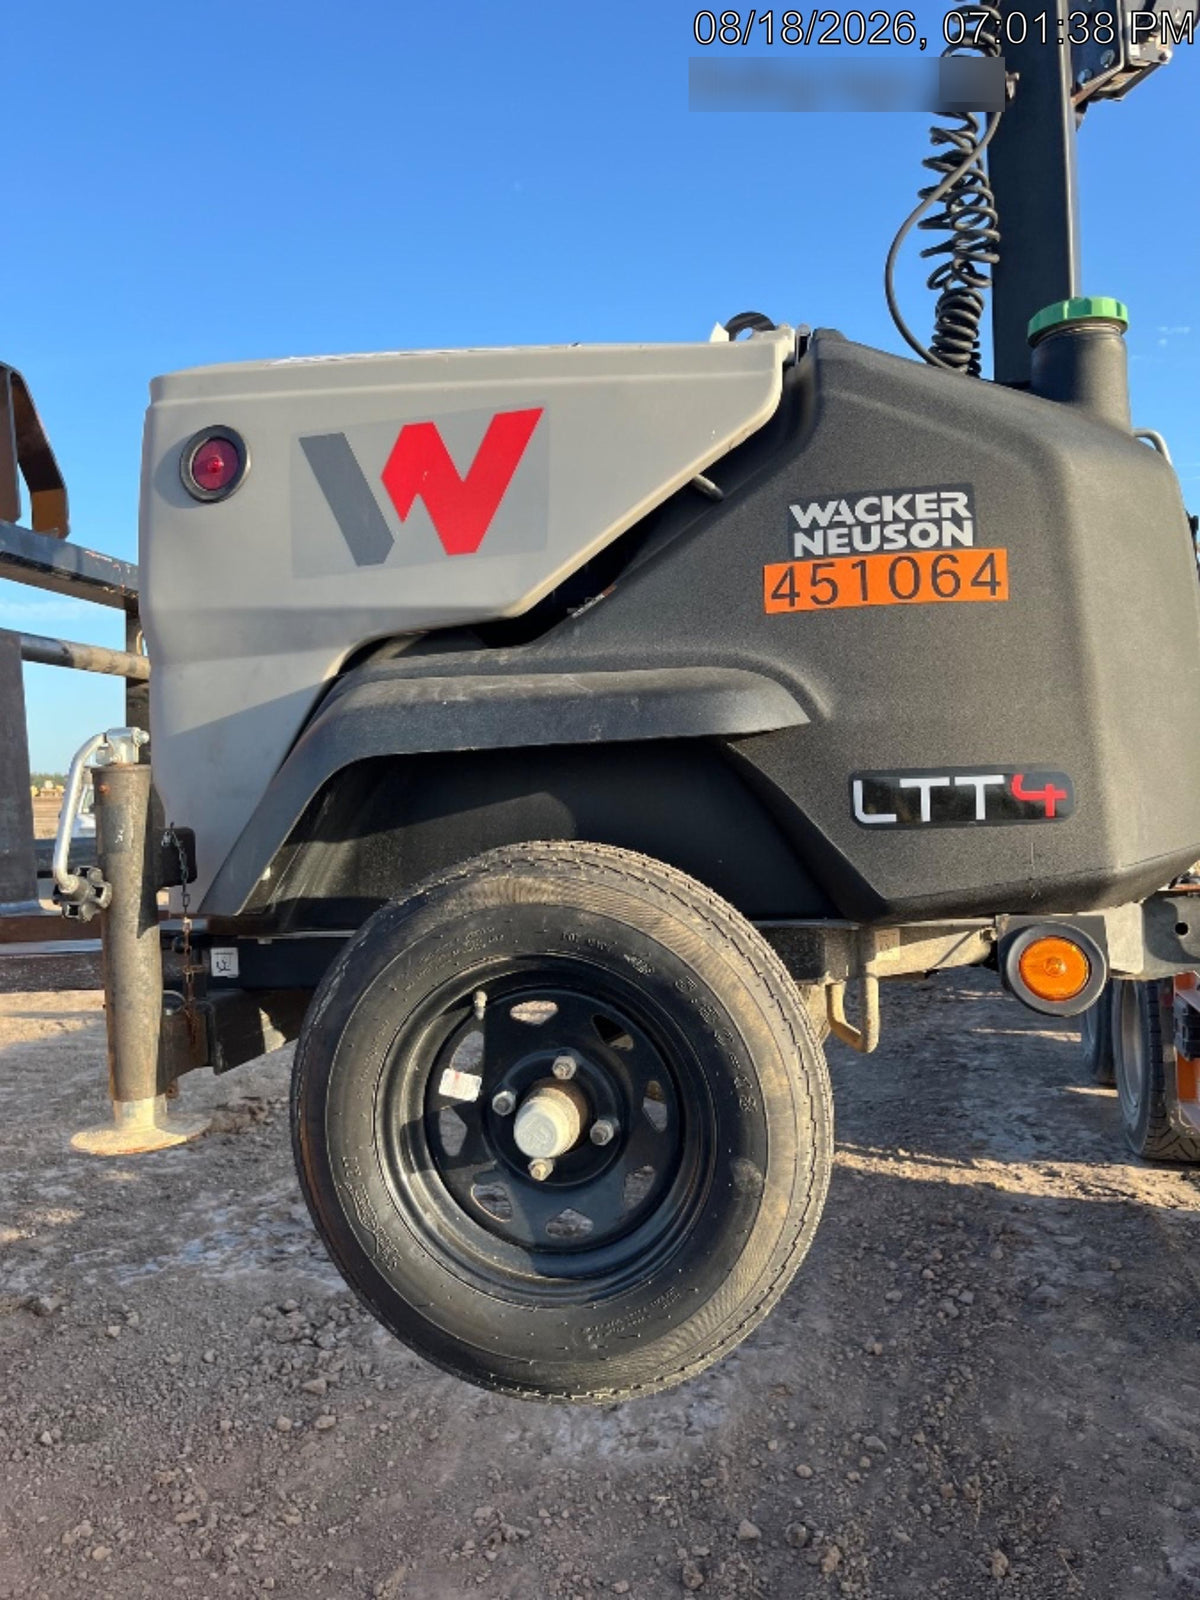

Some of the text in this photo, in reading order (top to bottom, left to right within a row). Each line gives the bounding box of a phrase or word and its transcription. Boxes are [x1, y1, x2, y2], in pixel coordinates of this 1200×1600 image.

[789, 491, 972, 529] WACKER
[793, 520, 973, 558] NEUSON
[771, 552, 1001, 607] 451064
[853, 774, 1067, 824] LTT4
